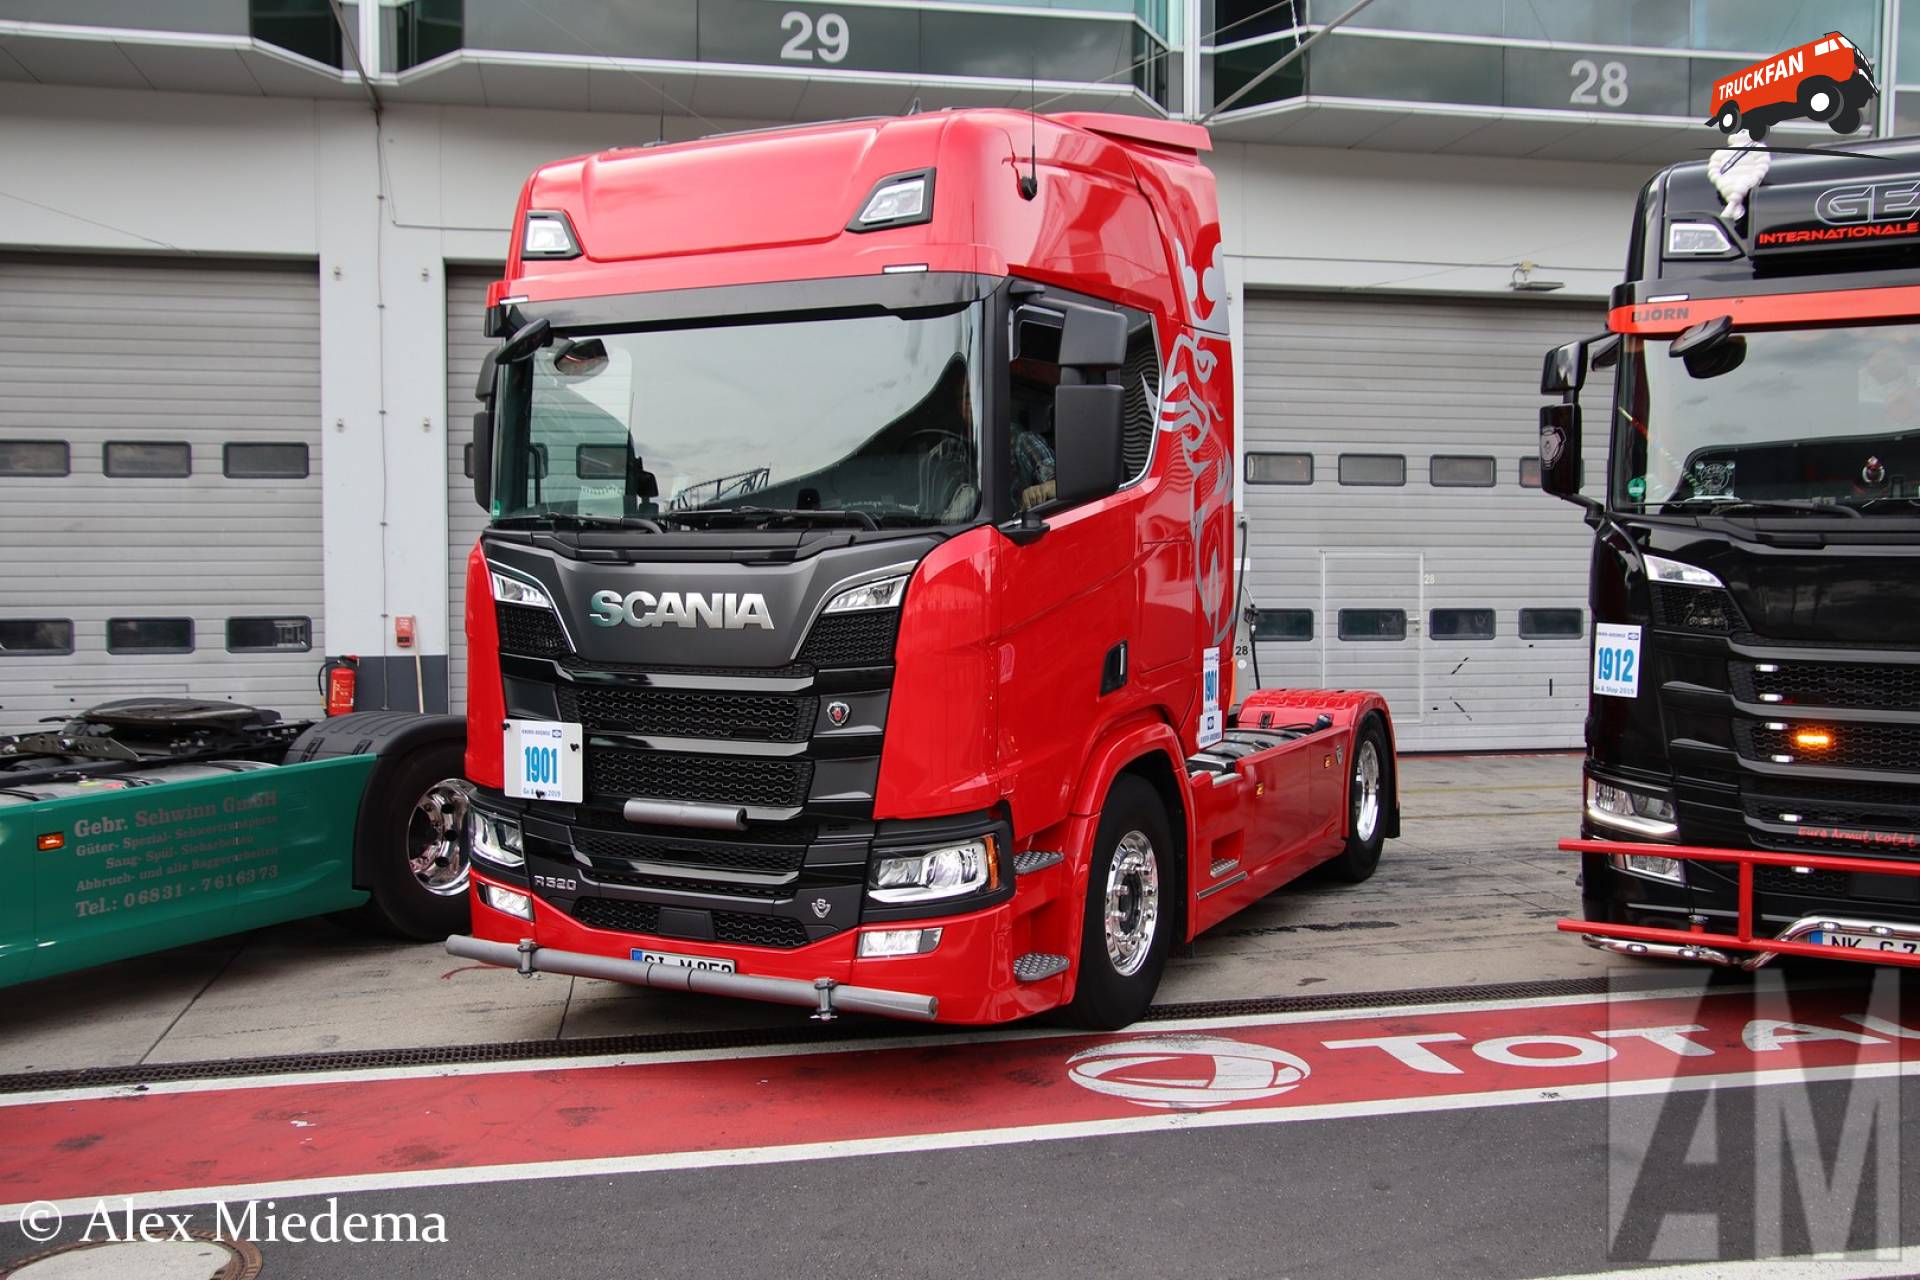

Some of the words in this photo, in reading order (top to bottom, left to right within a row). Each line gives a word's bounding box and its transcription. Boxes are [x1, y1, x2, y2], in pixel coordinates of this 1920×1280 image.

[781, 11, 849, 62] 29
[1569, 59, 1628, 107] 28
[1759, 222, 1919, 244] INTERNATIONALE
[589, 589, 775, 631] SCANIA
[1236, 646, 1248, 655] 28
[1598, 647, 1634, 682] 1912
[525, 746, 557, 784] 1901
[74, 816, 128, 838] Gebr.
[135, 804, 216, 828] Schwinn
[76, 843, 118, 857] Güter-
[139, 866, 163, 880] und
[534, 875, 577, 891] R520
[75, 897, 118, 917] Tel.:
